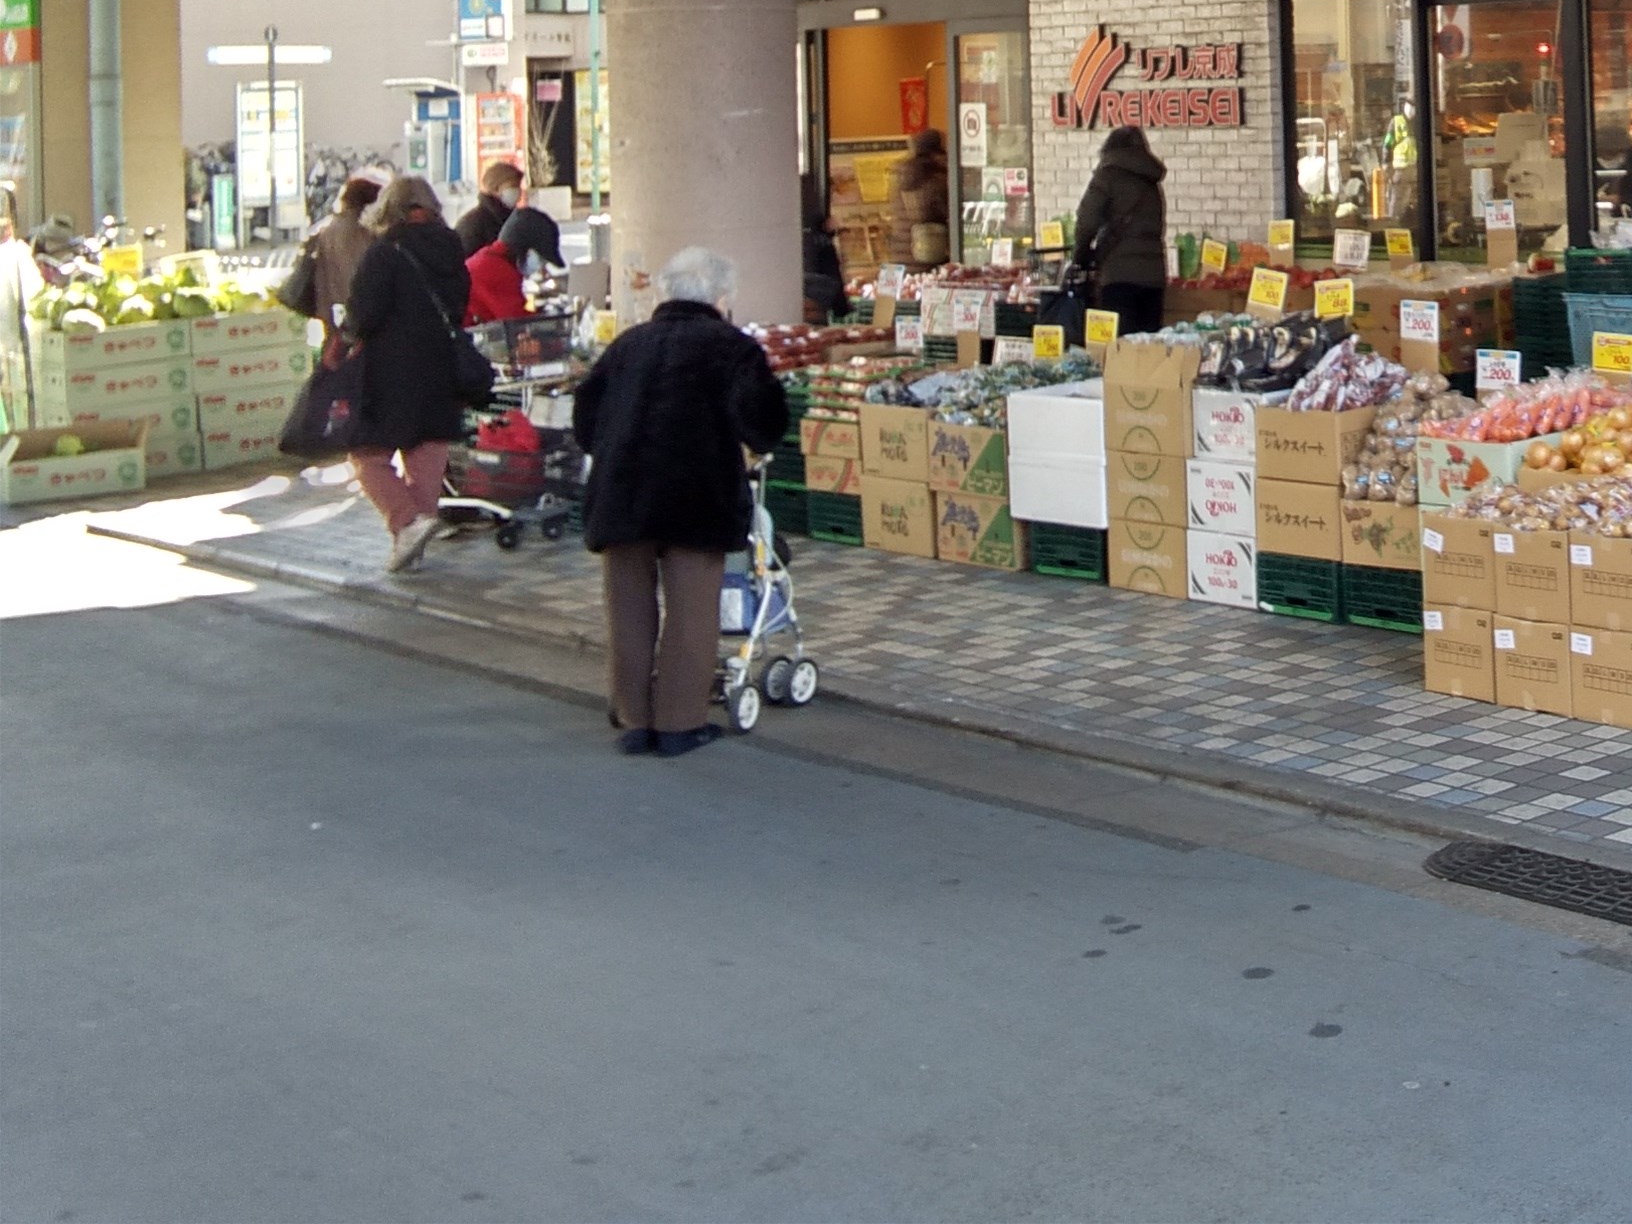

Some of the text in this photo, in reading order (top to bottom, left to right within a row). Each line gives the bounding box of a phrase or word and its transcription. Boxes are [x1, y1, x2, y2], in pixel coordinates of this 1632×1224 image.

[1135, 42, 1238, 81] リブレ京成
[1411, 318, 1431, 330] 200
[1490, 368, 1512, 380] 200
